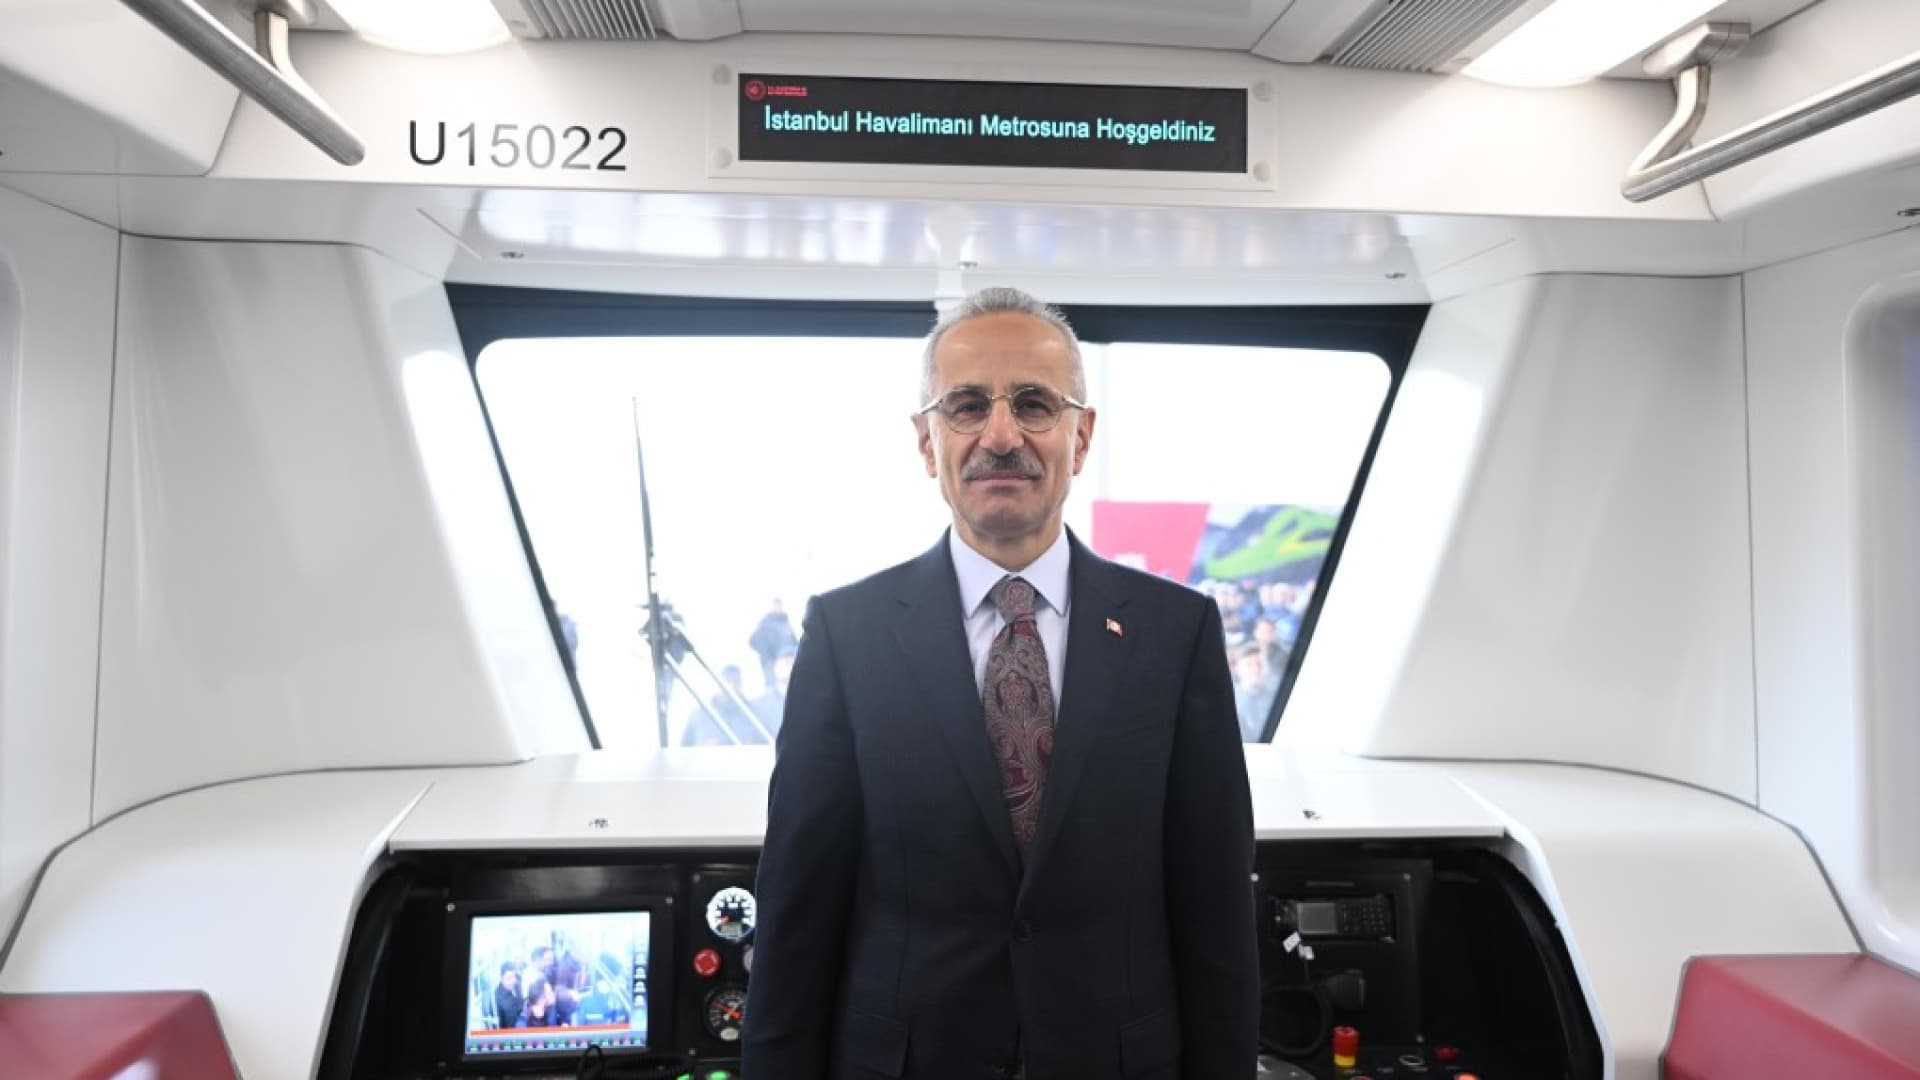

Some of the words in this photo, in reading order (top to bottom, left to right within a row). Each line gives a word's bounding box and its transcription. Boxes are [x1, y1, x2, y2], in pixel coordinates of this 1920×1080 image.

[409, 119, 628, 172] U15022
[764, 104, 849, 132] İstanbul
[855, 110, 974, 136] Havalimanı
[980, 113, 1090, 139] Metrosuna
[1096, 117, 1216, 145] Hoşgeldiniz
